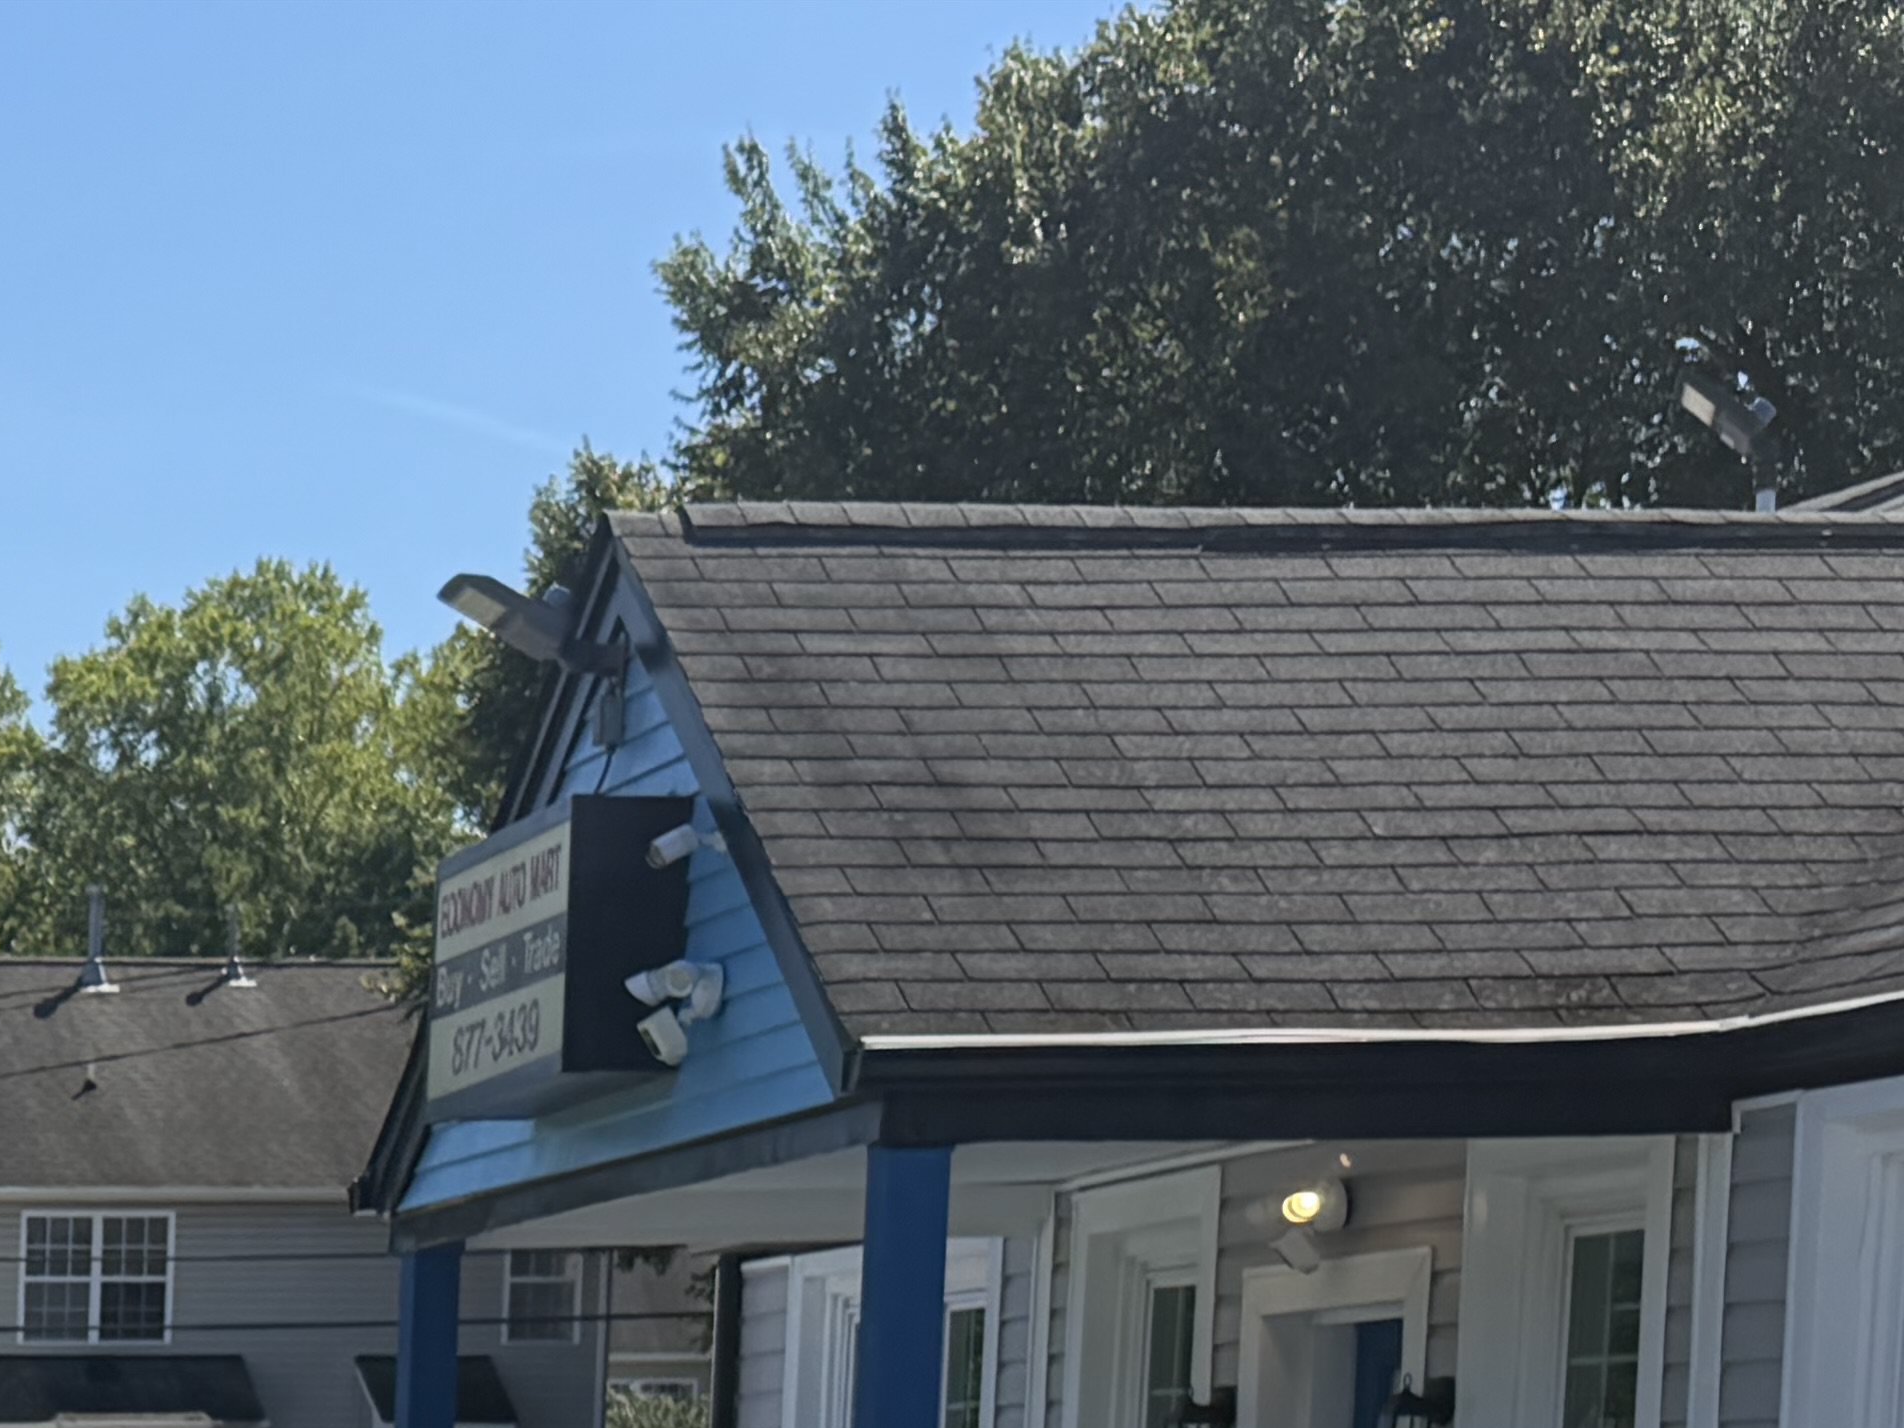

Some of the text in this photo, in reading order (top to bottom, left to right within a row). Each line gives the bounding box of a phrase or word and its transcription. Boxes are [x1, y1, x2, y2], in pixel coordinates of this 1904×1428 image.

[498, 861, 527, 916] AUTO
[530, 843, 562, 901] MART
[523, 924, 560, 974] Trade
